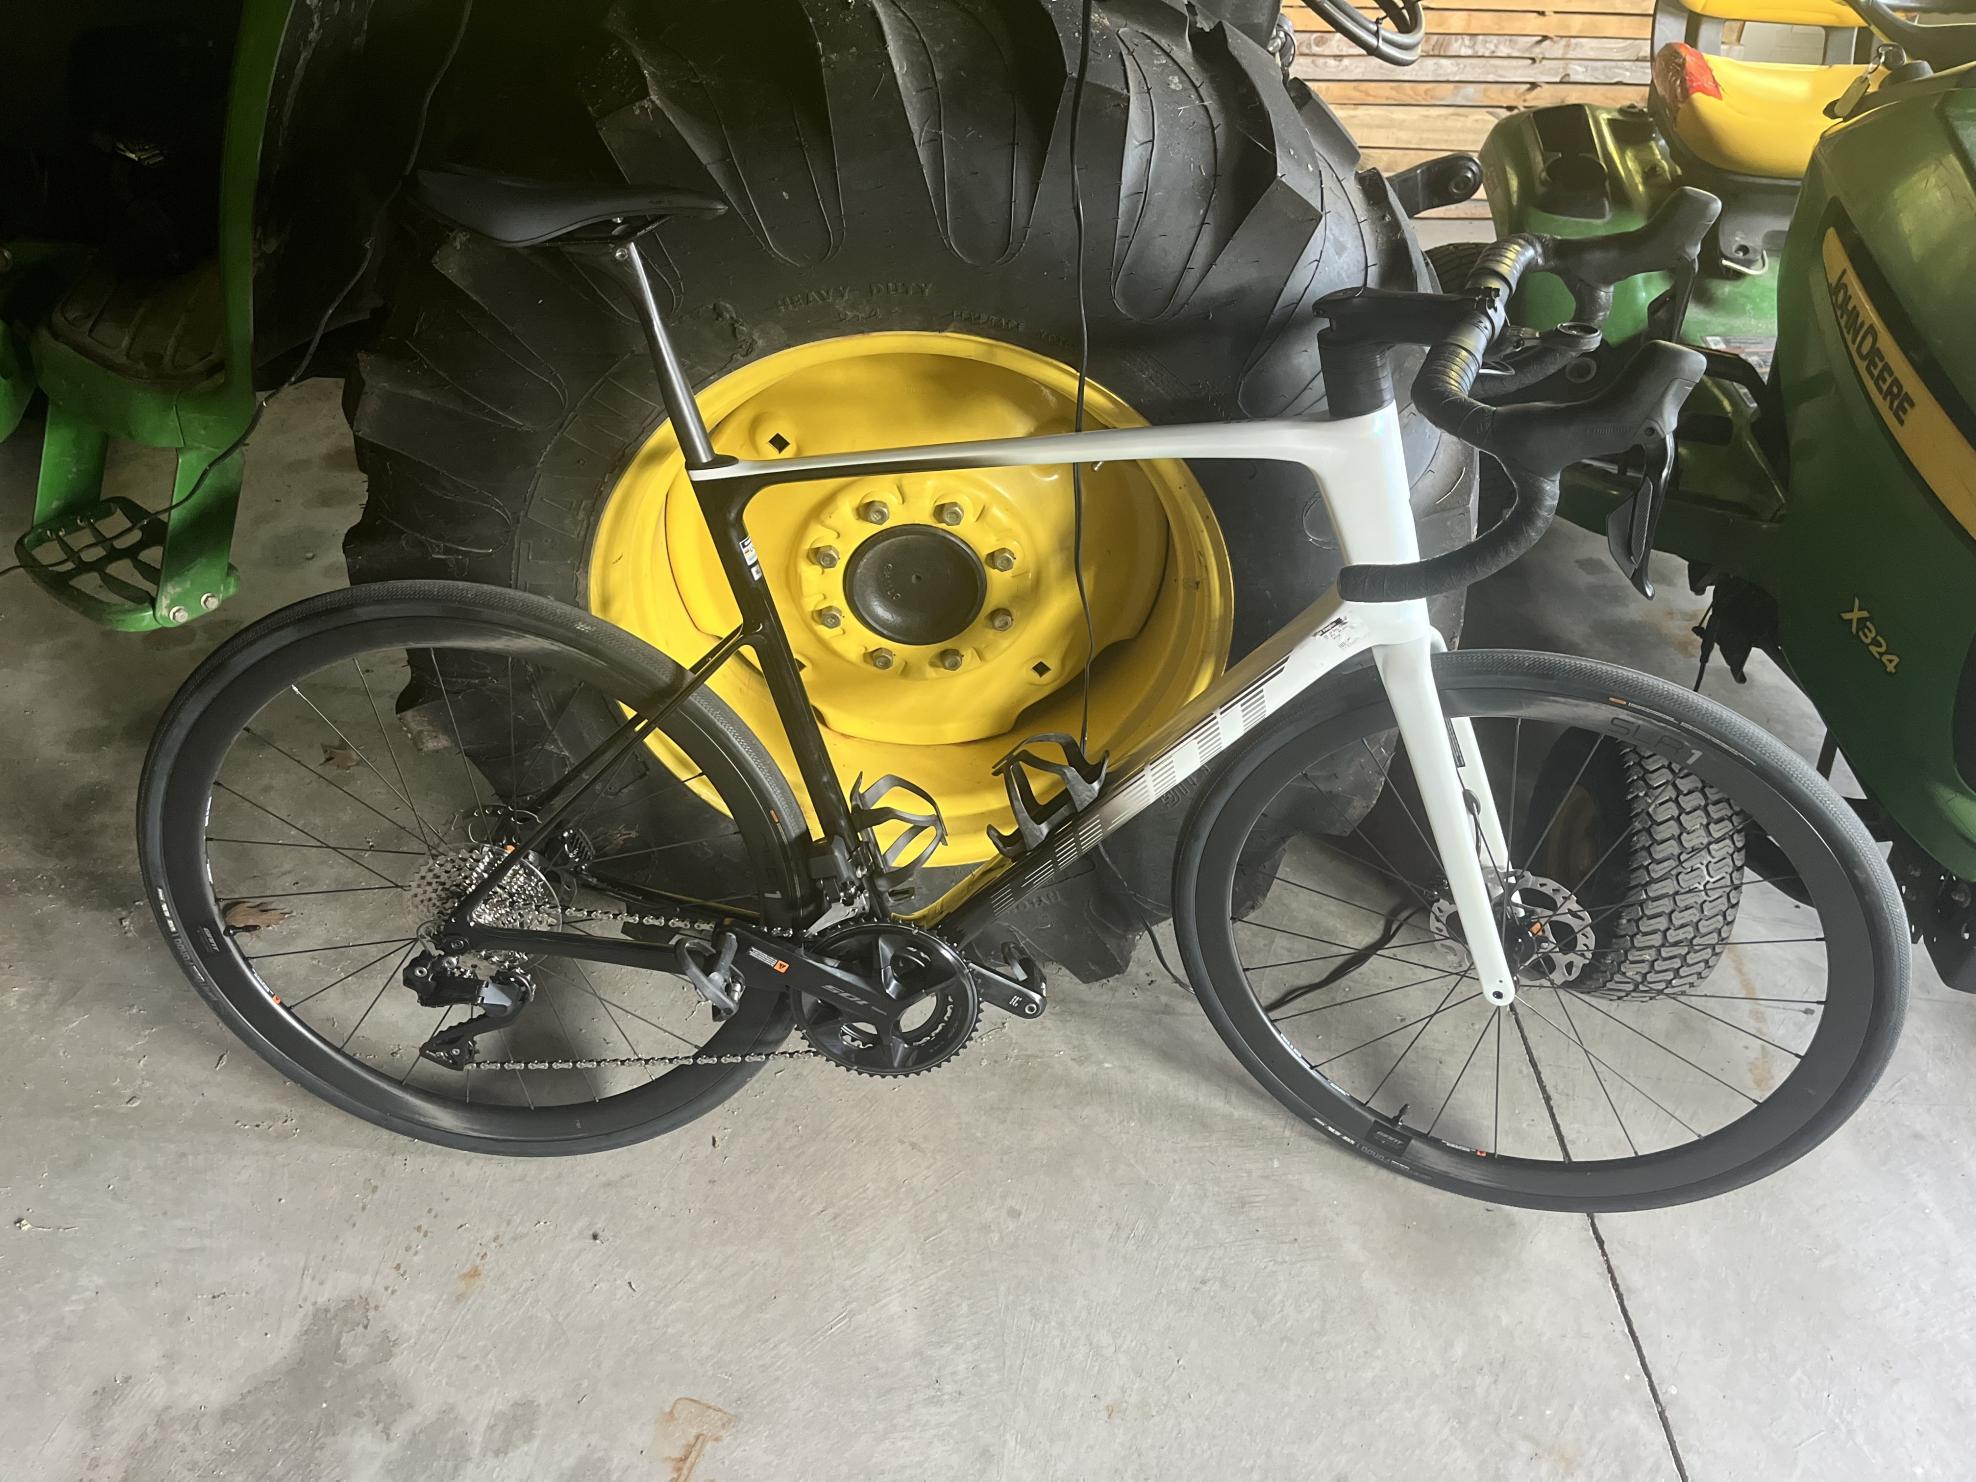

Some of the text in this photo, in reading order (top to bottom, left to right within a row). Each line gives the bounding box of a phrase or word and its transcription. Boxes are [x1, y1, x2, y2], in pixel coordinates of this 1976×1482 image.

[776, 281, 934, 312] HEAVY DUTY
[1829, 267, 1917, 427] JOHN DEERE
[1839, 596, 1901, 675] X324
